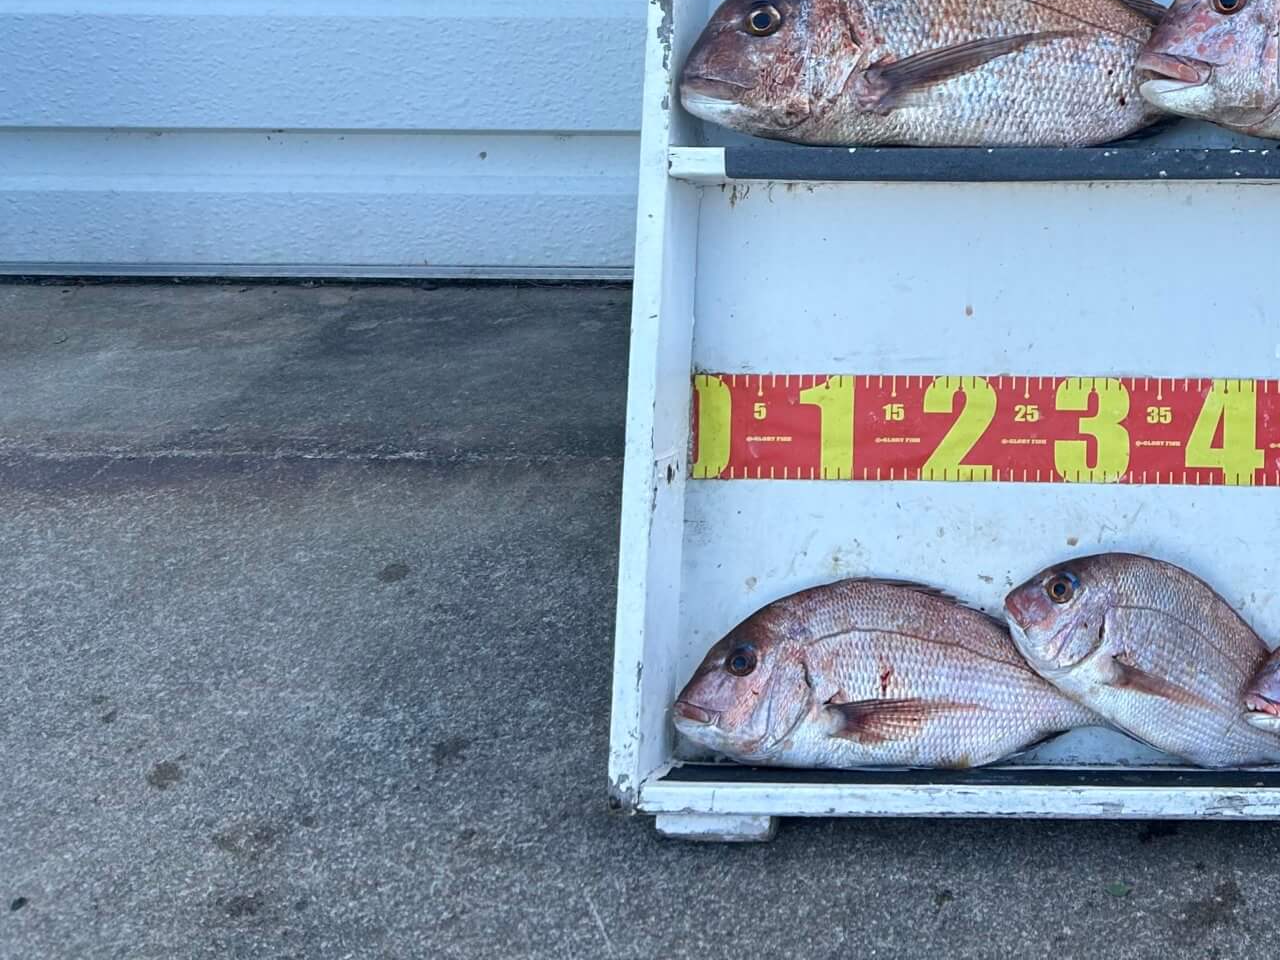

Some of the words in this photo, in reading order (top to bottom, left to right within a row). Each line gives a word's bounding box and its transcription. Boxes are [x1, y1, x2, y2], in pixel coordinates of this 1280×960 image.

[753, 402, 767, 421] 5
[883, 403, 905, 422] 15
[1014, 404, 1040, 422] 25
[1146, 406, 1173, 424] 35
[799, 374, 855, 480] 1
[922, 375, 998, 481] 2
[1054, 376, 1131, 484] 3
[1185, 378, 1265, 486] 4
